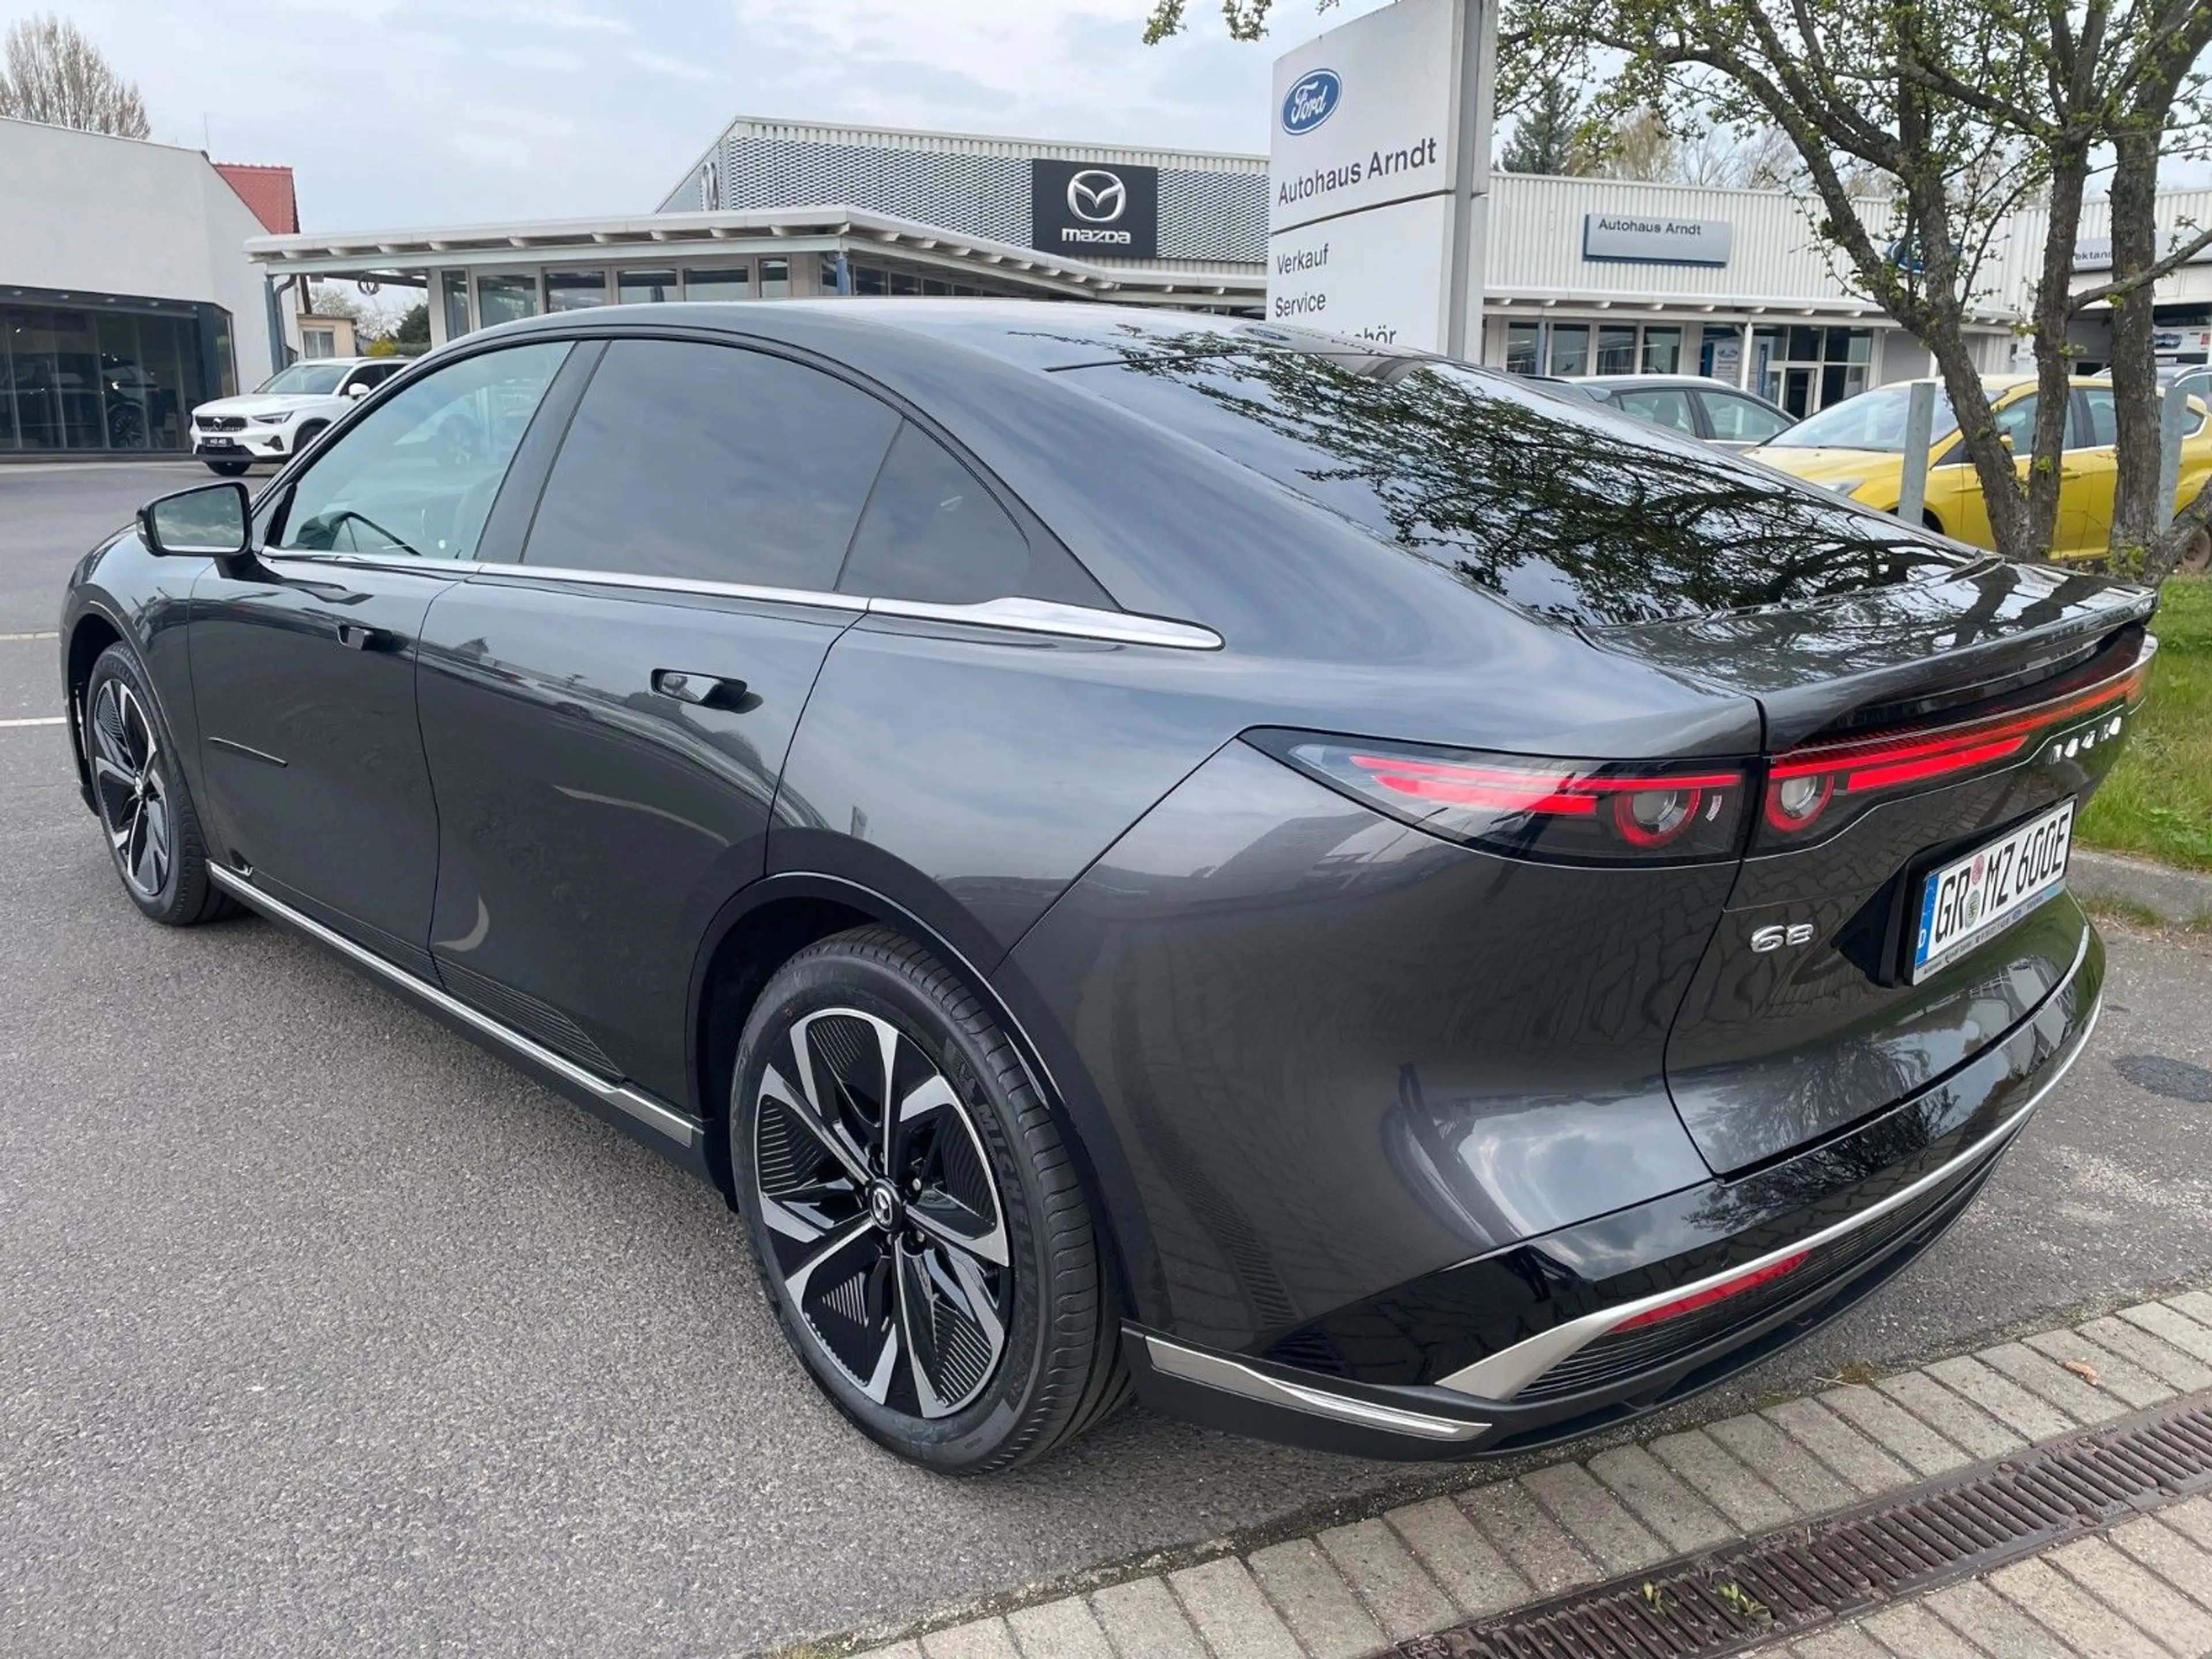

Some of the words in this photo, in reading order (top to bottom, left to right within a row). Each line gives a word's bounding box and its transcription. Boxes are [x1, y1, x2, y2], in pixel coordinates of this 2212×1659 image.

[1278, 162, 1361, 206] Autohaus
[1367, 137, 1437, 179] Arndt
[1061, 228, 1131, 245] mazda
[1598, 218, 1661, 233] Autohaus
[1665, 222, 1702, 236] Arndt
[1277, 242, 1329, 275] Verkauf
[1275, 291, 1326, 318] Service
[1935, 866, 1971, 944] GR
[1980, 841, 2016, 918] MZ
[2016, 812, 2069, 895] 600E
[1918, 928, 1927, 949] D
